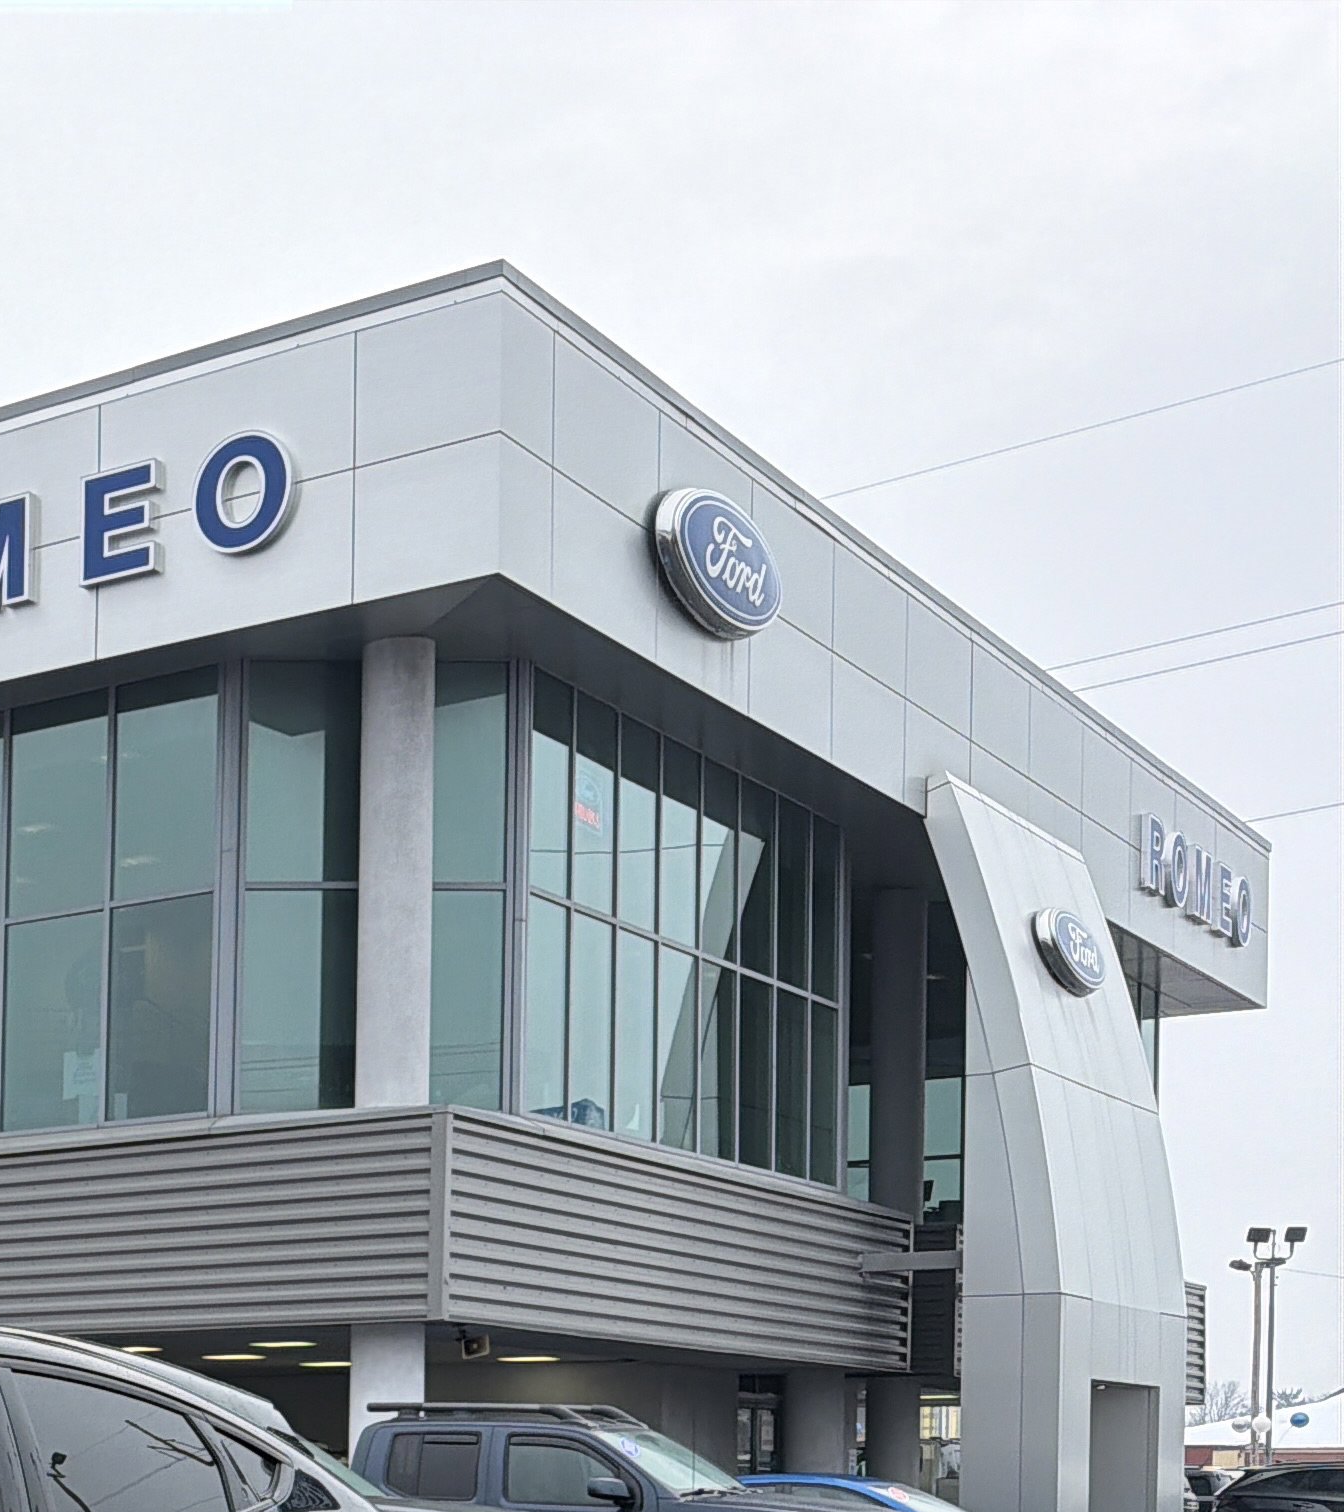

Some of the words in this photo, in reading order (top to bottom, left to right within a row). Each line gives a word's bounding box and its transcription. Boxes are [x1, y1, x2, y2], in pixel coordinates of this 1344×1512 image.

[706, 516, 767, 608] Ford
[1140, 813, 1253, 947] ROMEO
[1068, 922, 1100, 974] Ford
